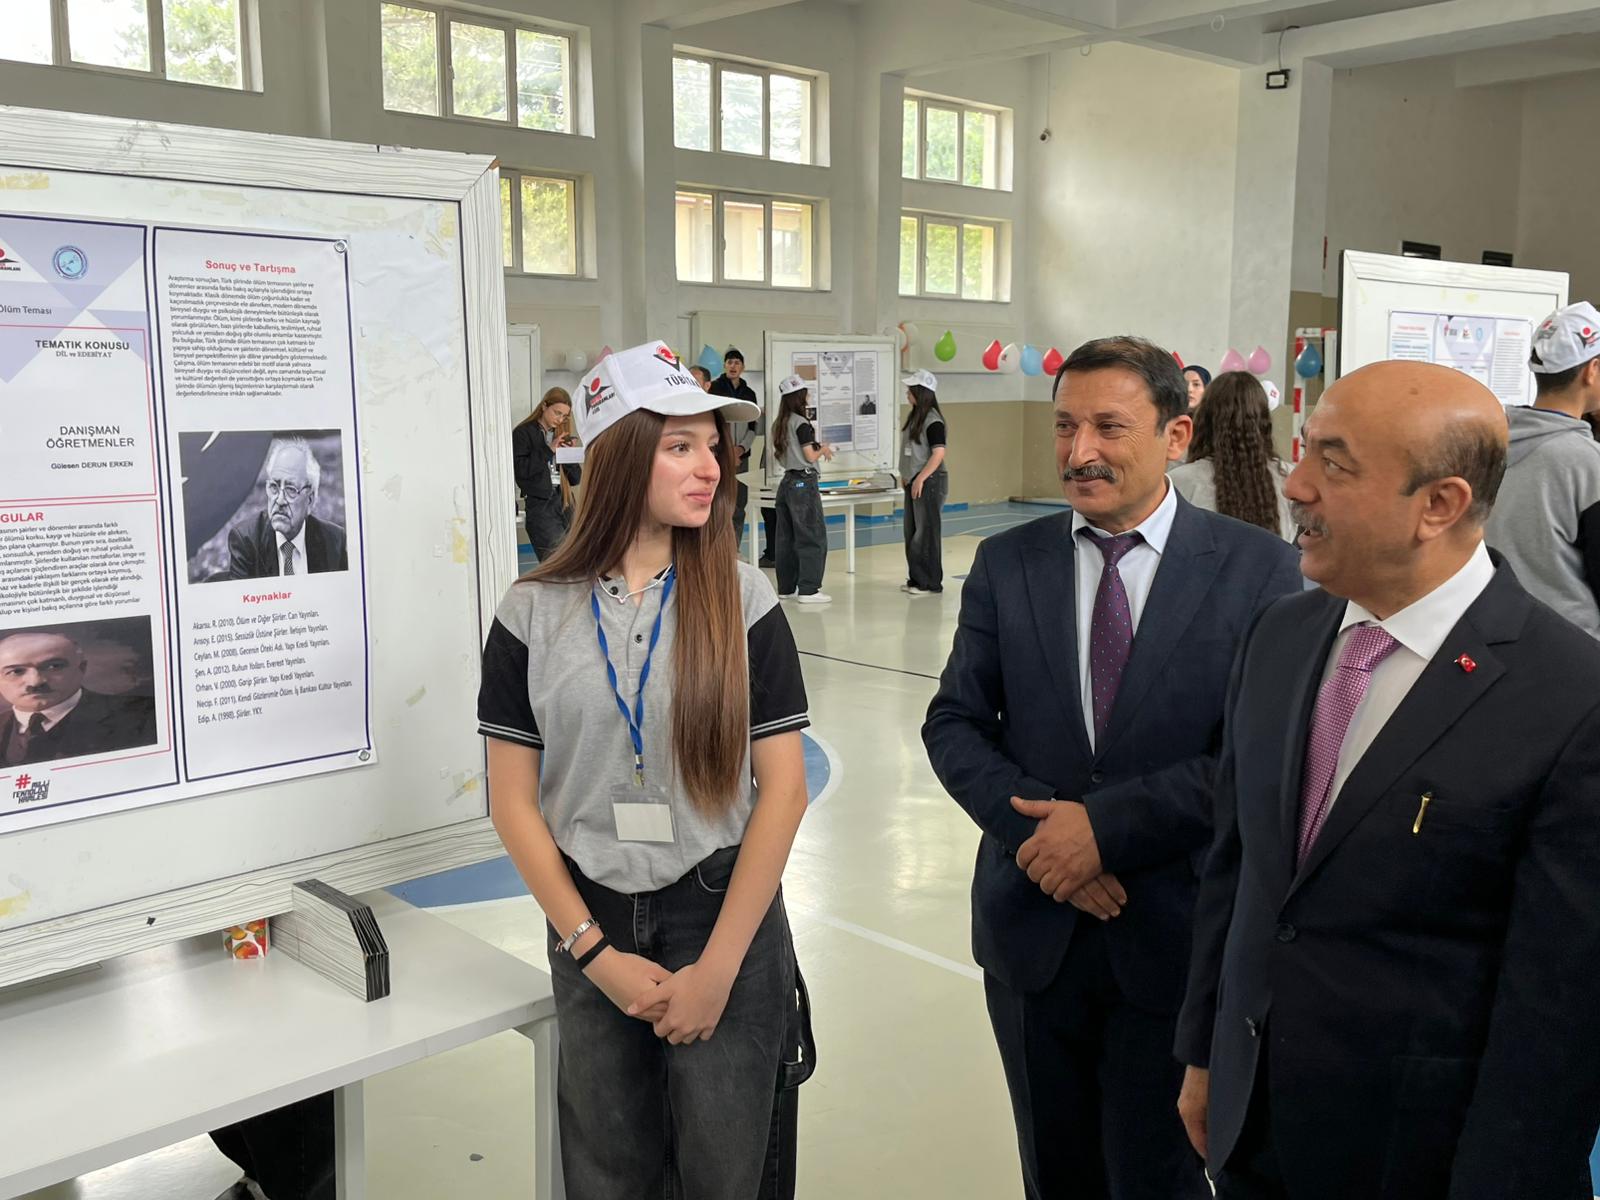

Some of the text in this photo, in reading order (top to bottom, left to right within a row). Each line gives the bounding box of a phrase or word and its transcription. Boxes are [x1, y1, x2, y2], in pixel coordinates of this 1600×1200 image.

[205, 260, 237, 272] Sonuç
[254, 263, 296, 275] Tartışma
[22, 306, 52, 315] Teması
[85, 341, 130, 351] KONUSU
[60, 425, 120, 437] DANIŞMAN
[46, 438, 135, 449] ÖĞRETMENLER
[242, 592, 292, 604] Kaynaklar
